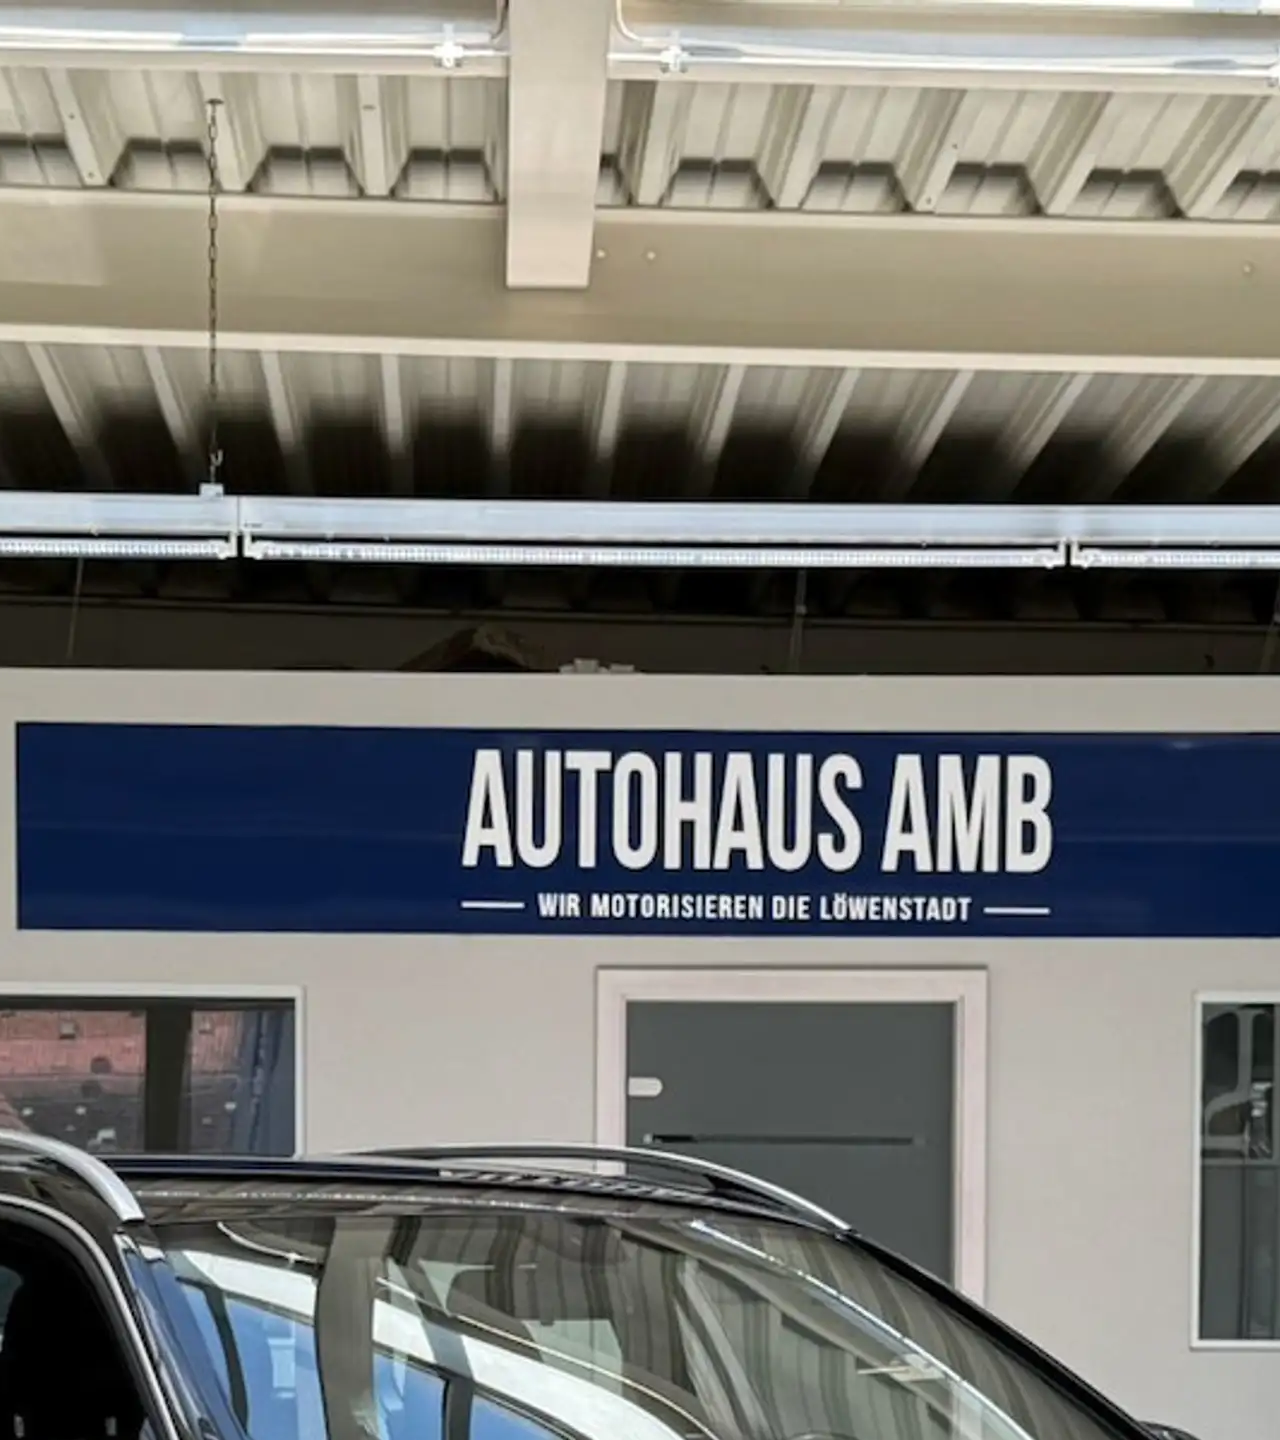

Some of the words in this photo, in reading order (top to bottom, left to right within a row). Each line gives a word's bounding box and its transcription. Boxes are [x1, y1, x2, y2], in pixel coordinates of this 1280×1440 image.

[462, 748, 864, 872] AUTOHAUS
[880, 753, 1054, 874] AMB
[537, 893, 581, 918] WIR
[591, 893, 764, 920] MOTORISIEREN
[771, 895, 815, 921] DIE
[819, 893, 973, 922] LÖWENSTADT
